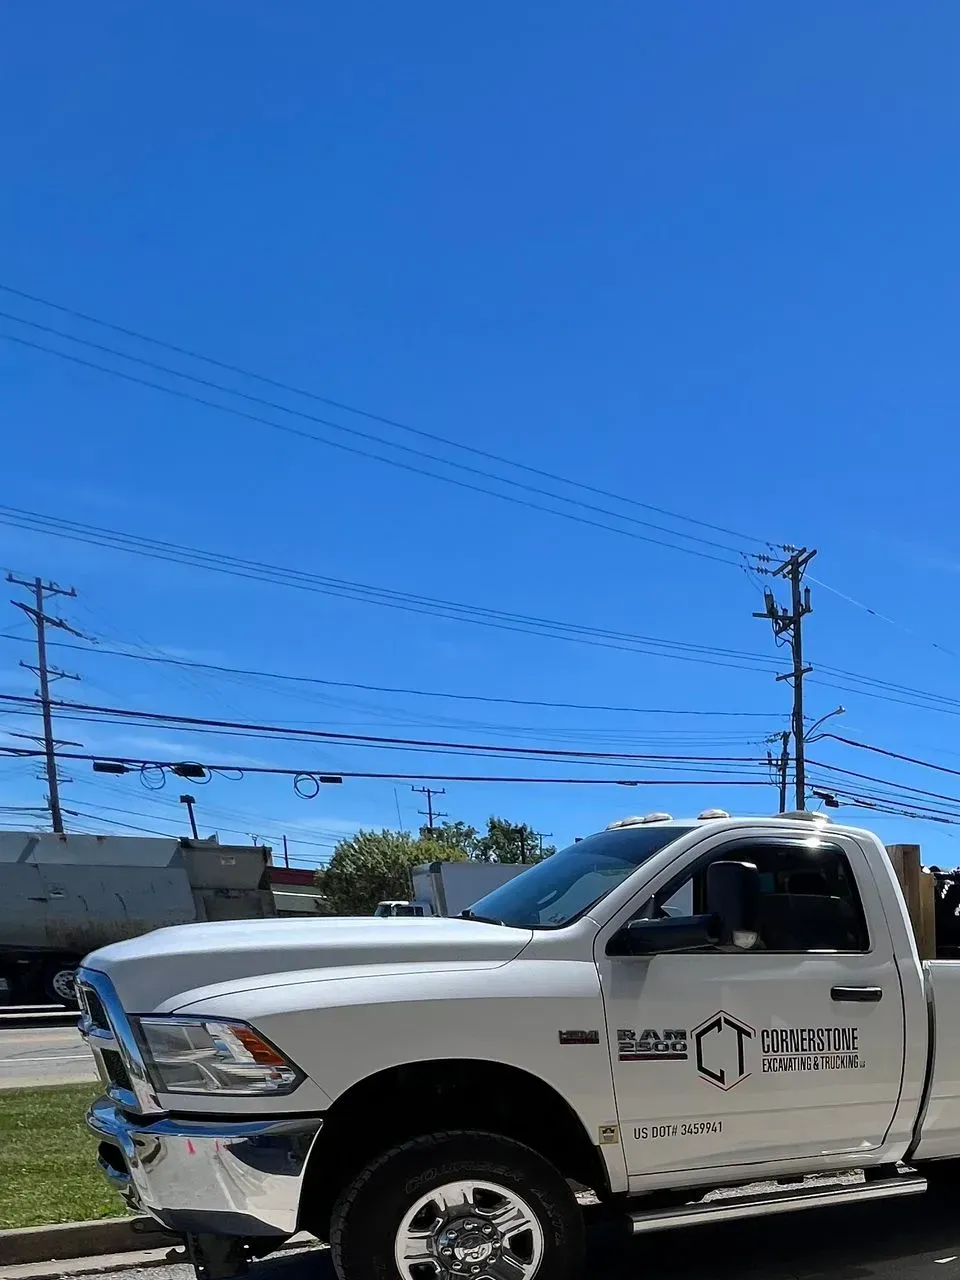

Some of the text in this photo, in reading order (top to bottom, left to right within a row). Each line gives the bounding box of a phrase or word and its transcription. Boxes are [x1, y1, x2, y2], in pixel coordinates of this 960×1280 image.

[617, 1029, 687, 1041] RAM
[761, 1028, 858, 1053] CORNERSTONE
[619, 1041, 688, 1053] 2500
[762, 1056, 811, 1072] EXCAVATING
[813, 1056, 819, 1071] &
[820, 1055, 859, 1070] TRUCKING
[633, 1121, 722, 1140] US DOT# 3459941
